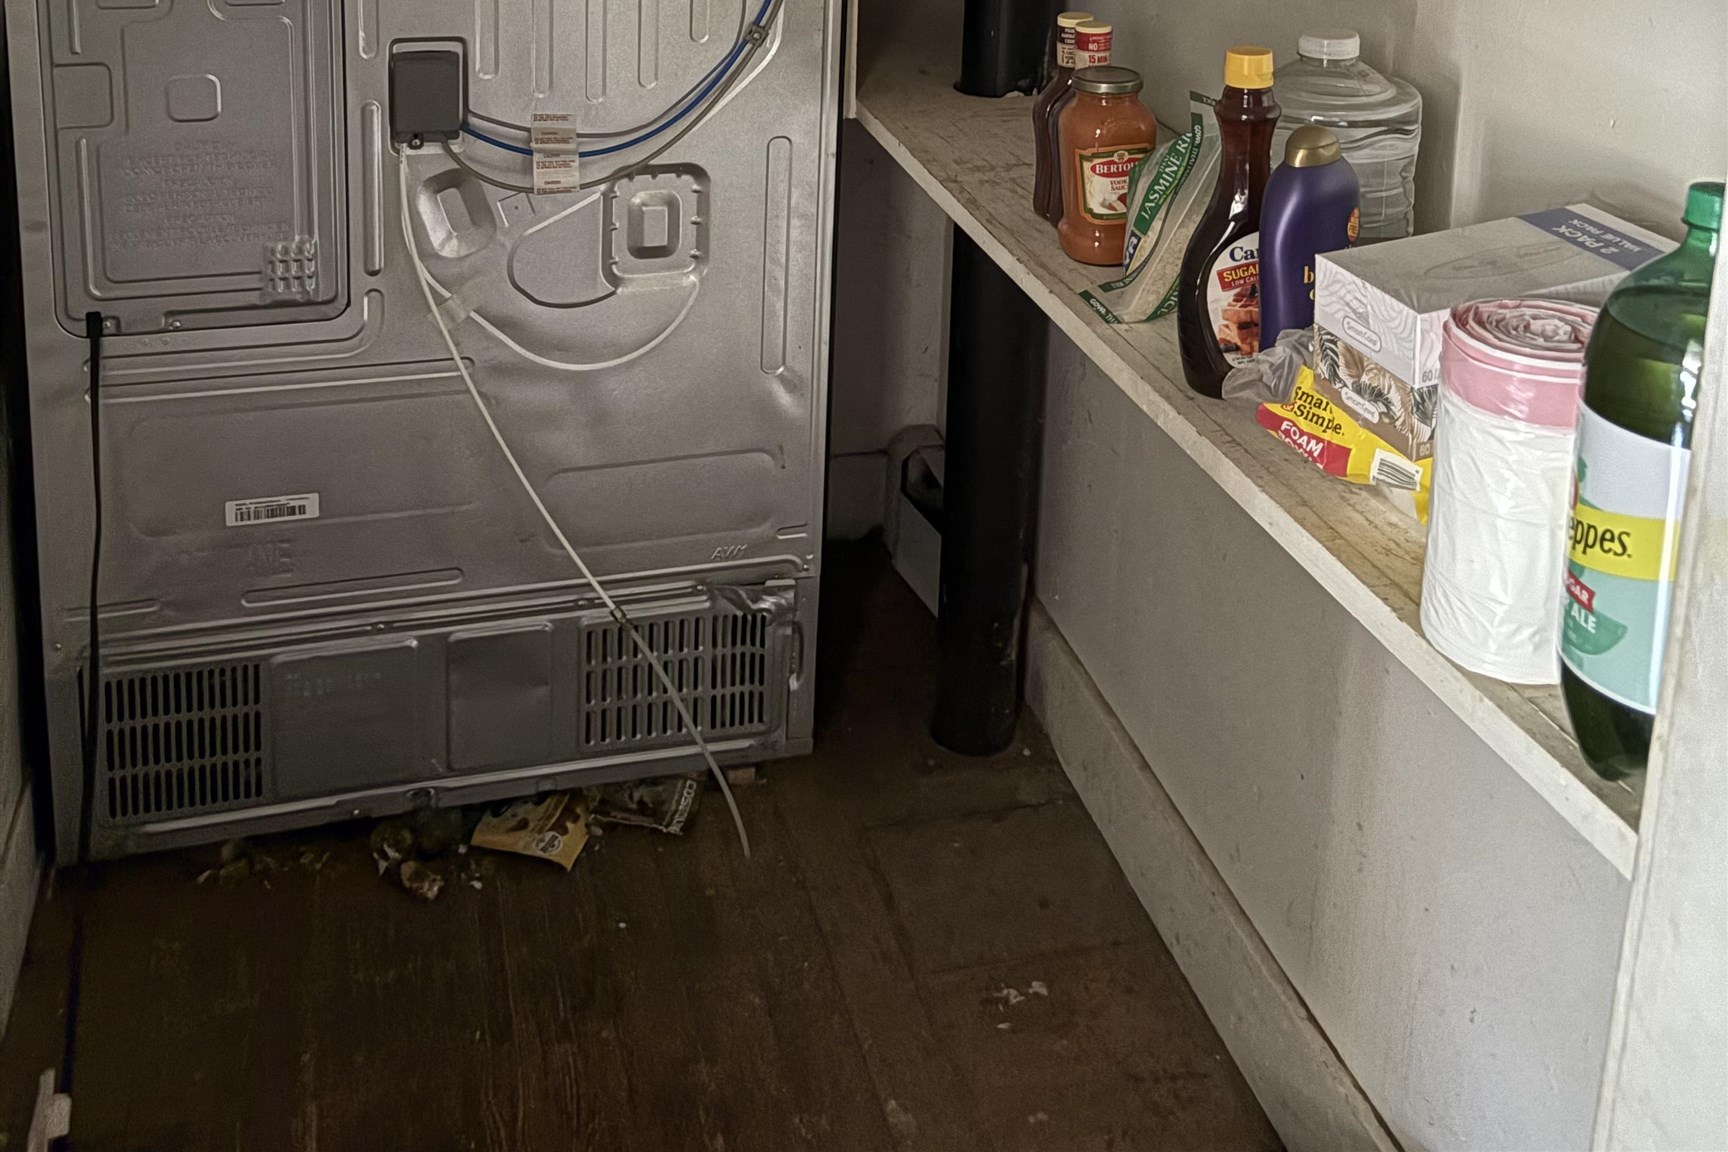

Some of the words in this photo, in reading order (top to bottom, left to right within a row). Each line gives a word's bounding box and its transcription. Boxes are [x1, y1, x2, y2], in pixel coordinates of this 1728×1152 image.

[1095, 162, 1135, 174] BERTO
[1141, 153, 1183, 220] JASMINE
[1552, 224, 1606, 248] PACK
[1568, 218, 1604, 235] PACK
[1600, 233, 1641, 253] VALUE
[1280, 419, 1324, 457] FOAM
[1567, 517, 1632, 558] eppes
[1571, 608, 1597, 633] ALE
